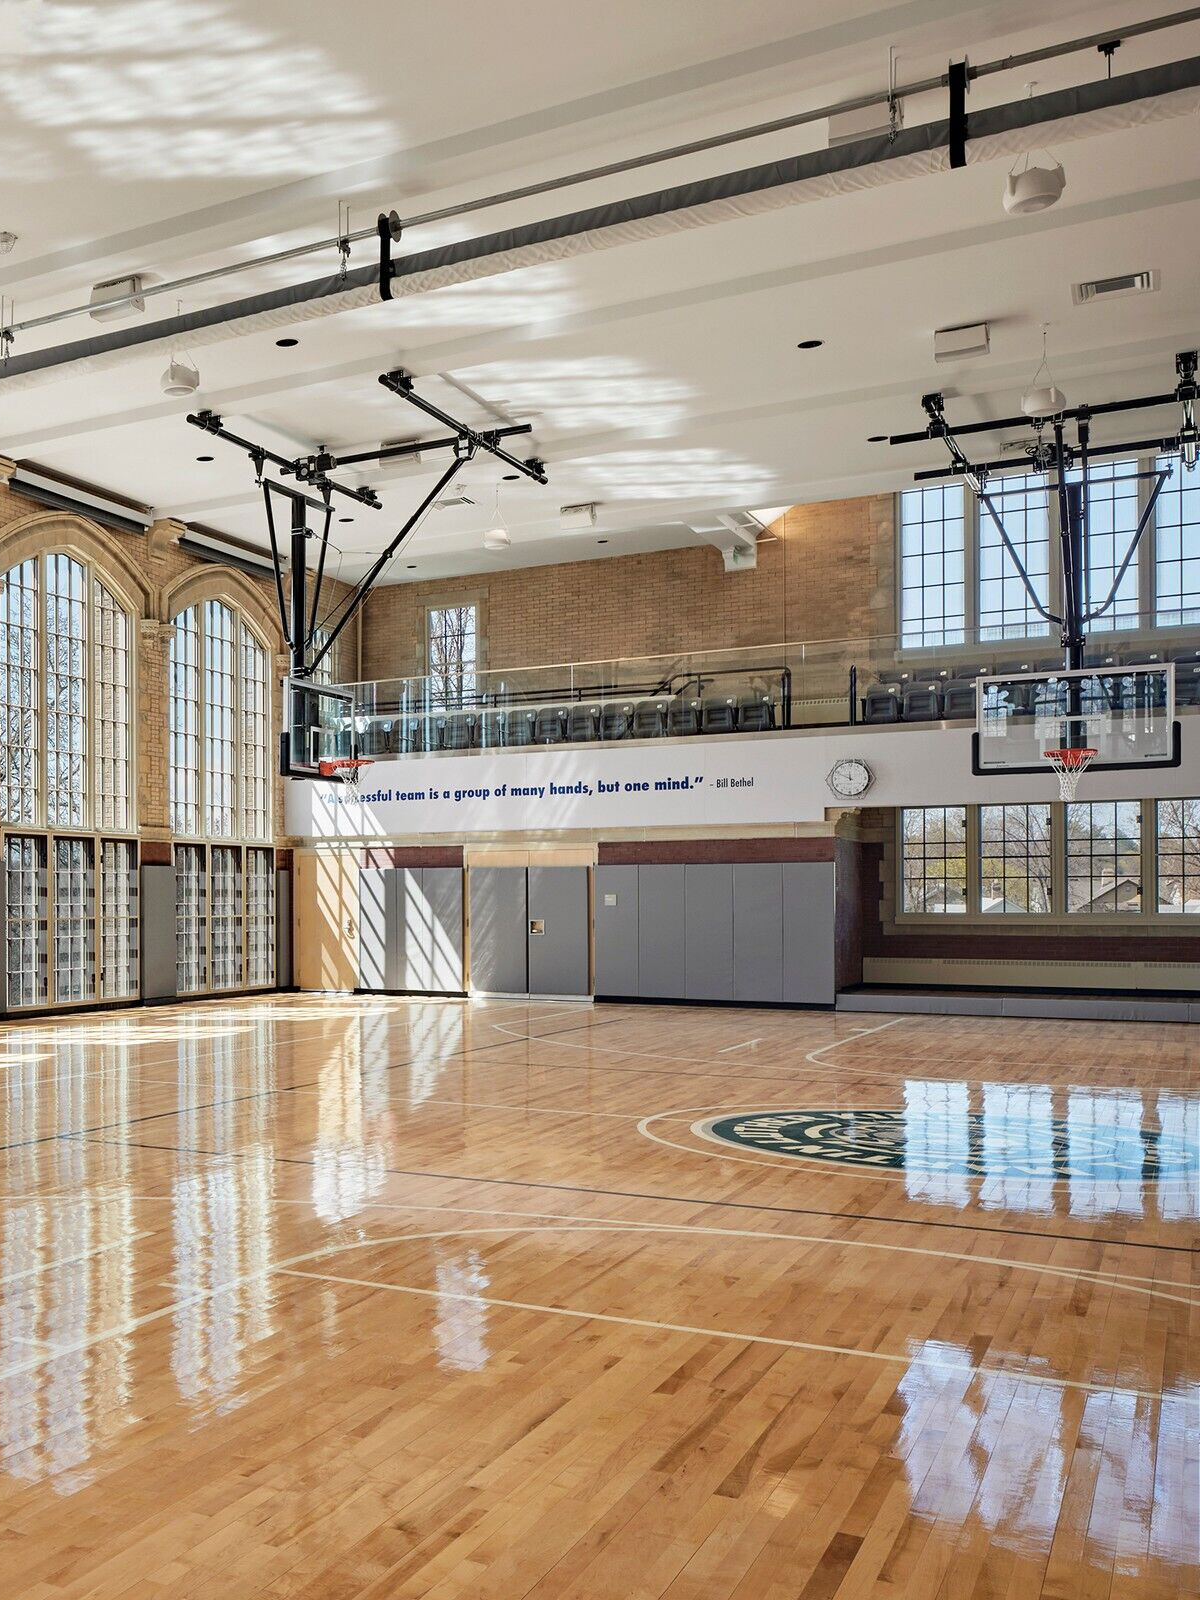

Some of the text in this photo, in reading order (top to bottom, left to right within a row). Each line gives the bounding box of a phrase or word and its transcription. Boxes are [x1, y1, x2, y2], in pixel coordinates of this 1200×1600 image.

[337, 788, 392, 804] sessful
[395, 789, 426, 801] team
[429, 787, 439, 800] is
[442, 789, 450, 799] a
[453, 787, 490, 802] group
[493, 784, 507, 797] of
[510, 785, 545, 799] many
[549, 781, 594, 797] hands,
[597, 779, 621, 794] but
[624, 781, 650, 792] one
[716, 778, 729, 788] Bill
[730, 776, 754, 788] Bethel
[733, 1113, 832, 1145] LUTHER
